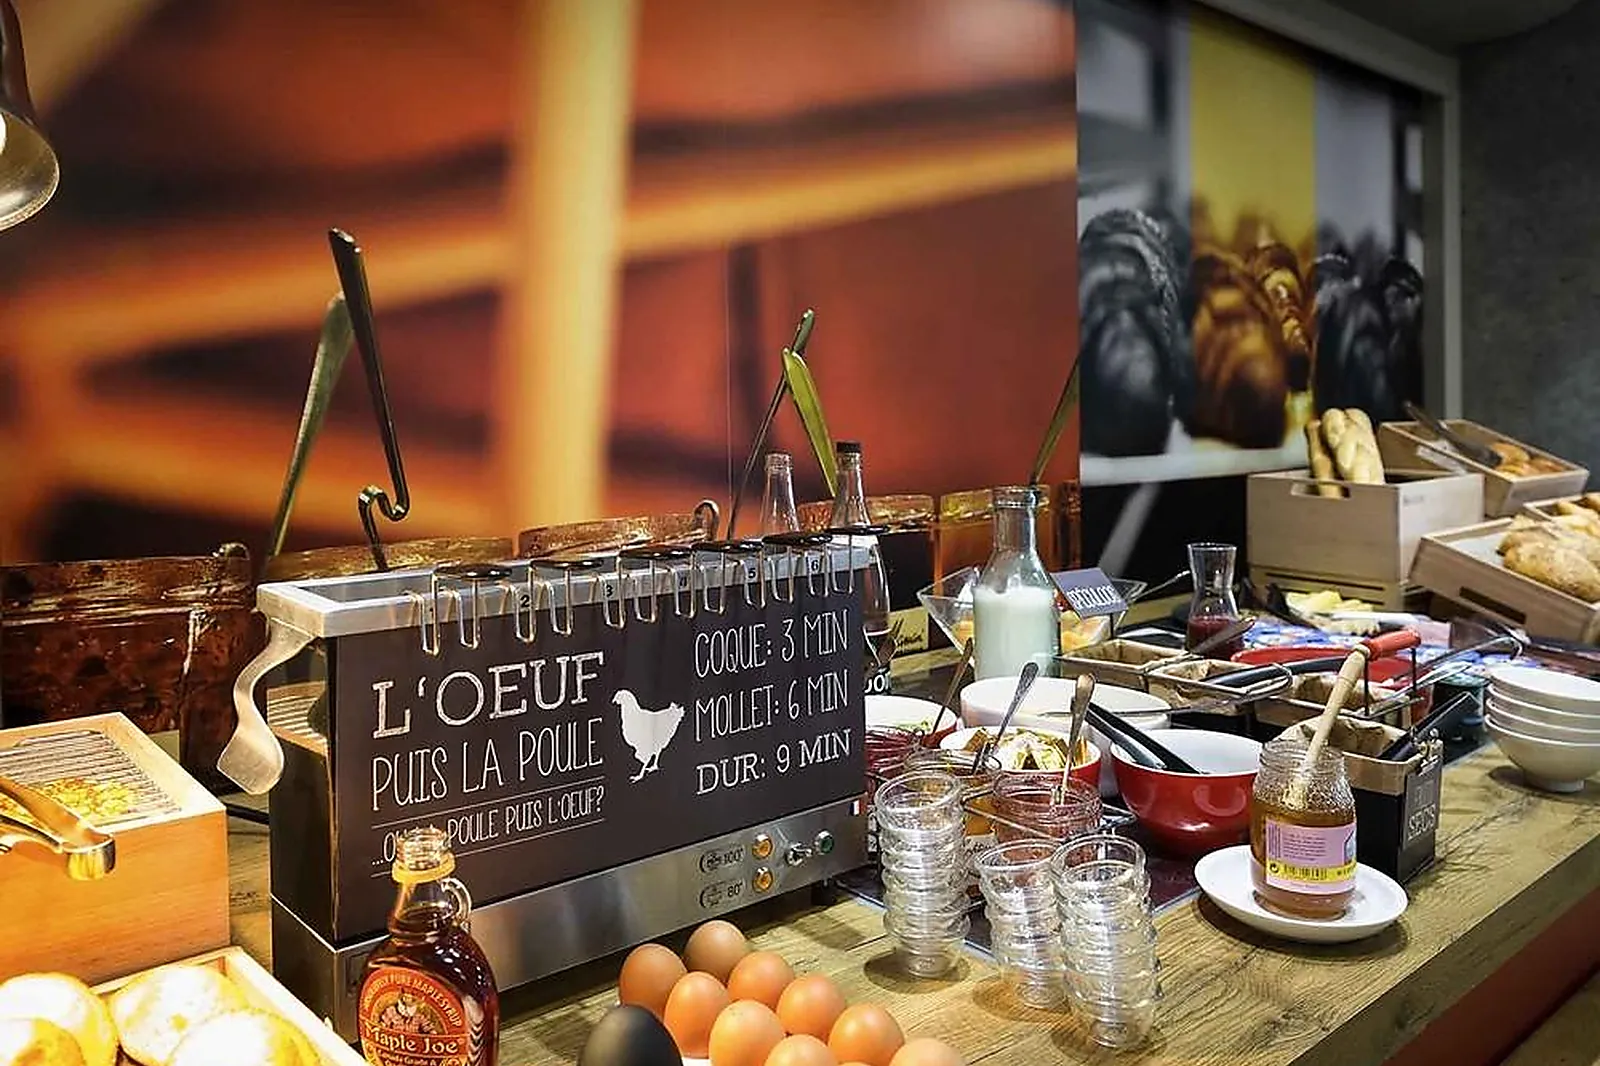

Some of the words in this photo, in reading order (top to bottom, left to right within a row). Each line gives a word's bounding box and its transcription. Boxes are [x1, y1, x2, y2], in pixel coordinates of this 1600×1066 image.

[747, 566, 756, 579] 5
[811, 559, 820, 571] 6
[520, 594, 531, 608] 2
[695, 623, 771, 678] COQUE:
[781, 618, 795, 662] 3
[803, 608, 849, 659] MIN
[695, 684, 780, 742] MOLLET:
[788, 679, 800, 720] 6
[807, 668, 848, 716] MIN
[372, 746, 448, 811] PUIS
[462, 738, 505, 793] LA
[519, 717, 604, 781] POULE
[696, 752, 766, 795] DUR:
[776, 744, 790, 773] 9
[798, 728, 851, 768] MIN
[447, 808, 499, 849] POULE
[506, 799, 542, 834] PUIS
[547, 785, 605, 824] L'OEUF?
[365, 1025, 418, 1051] Maple
[422, 1038, 459, 1053] Joe
